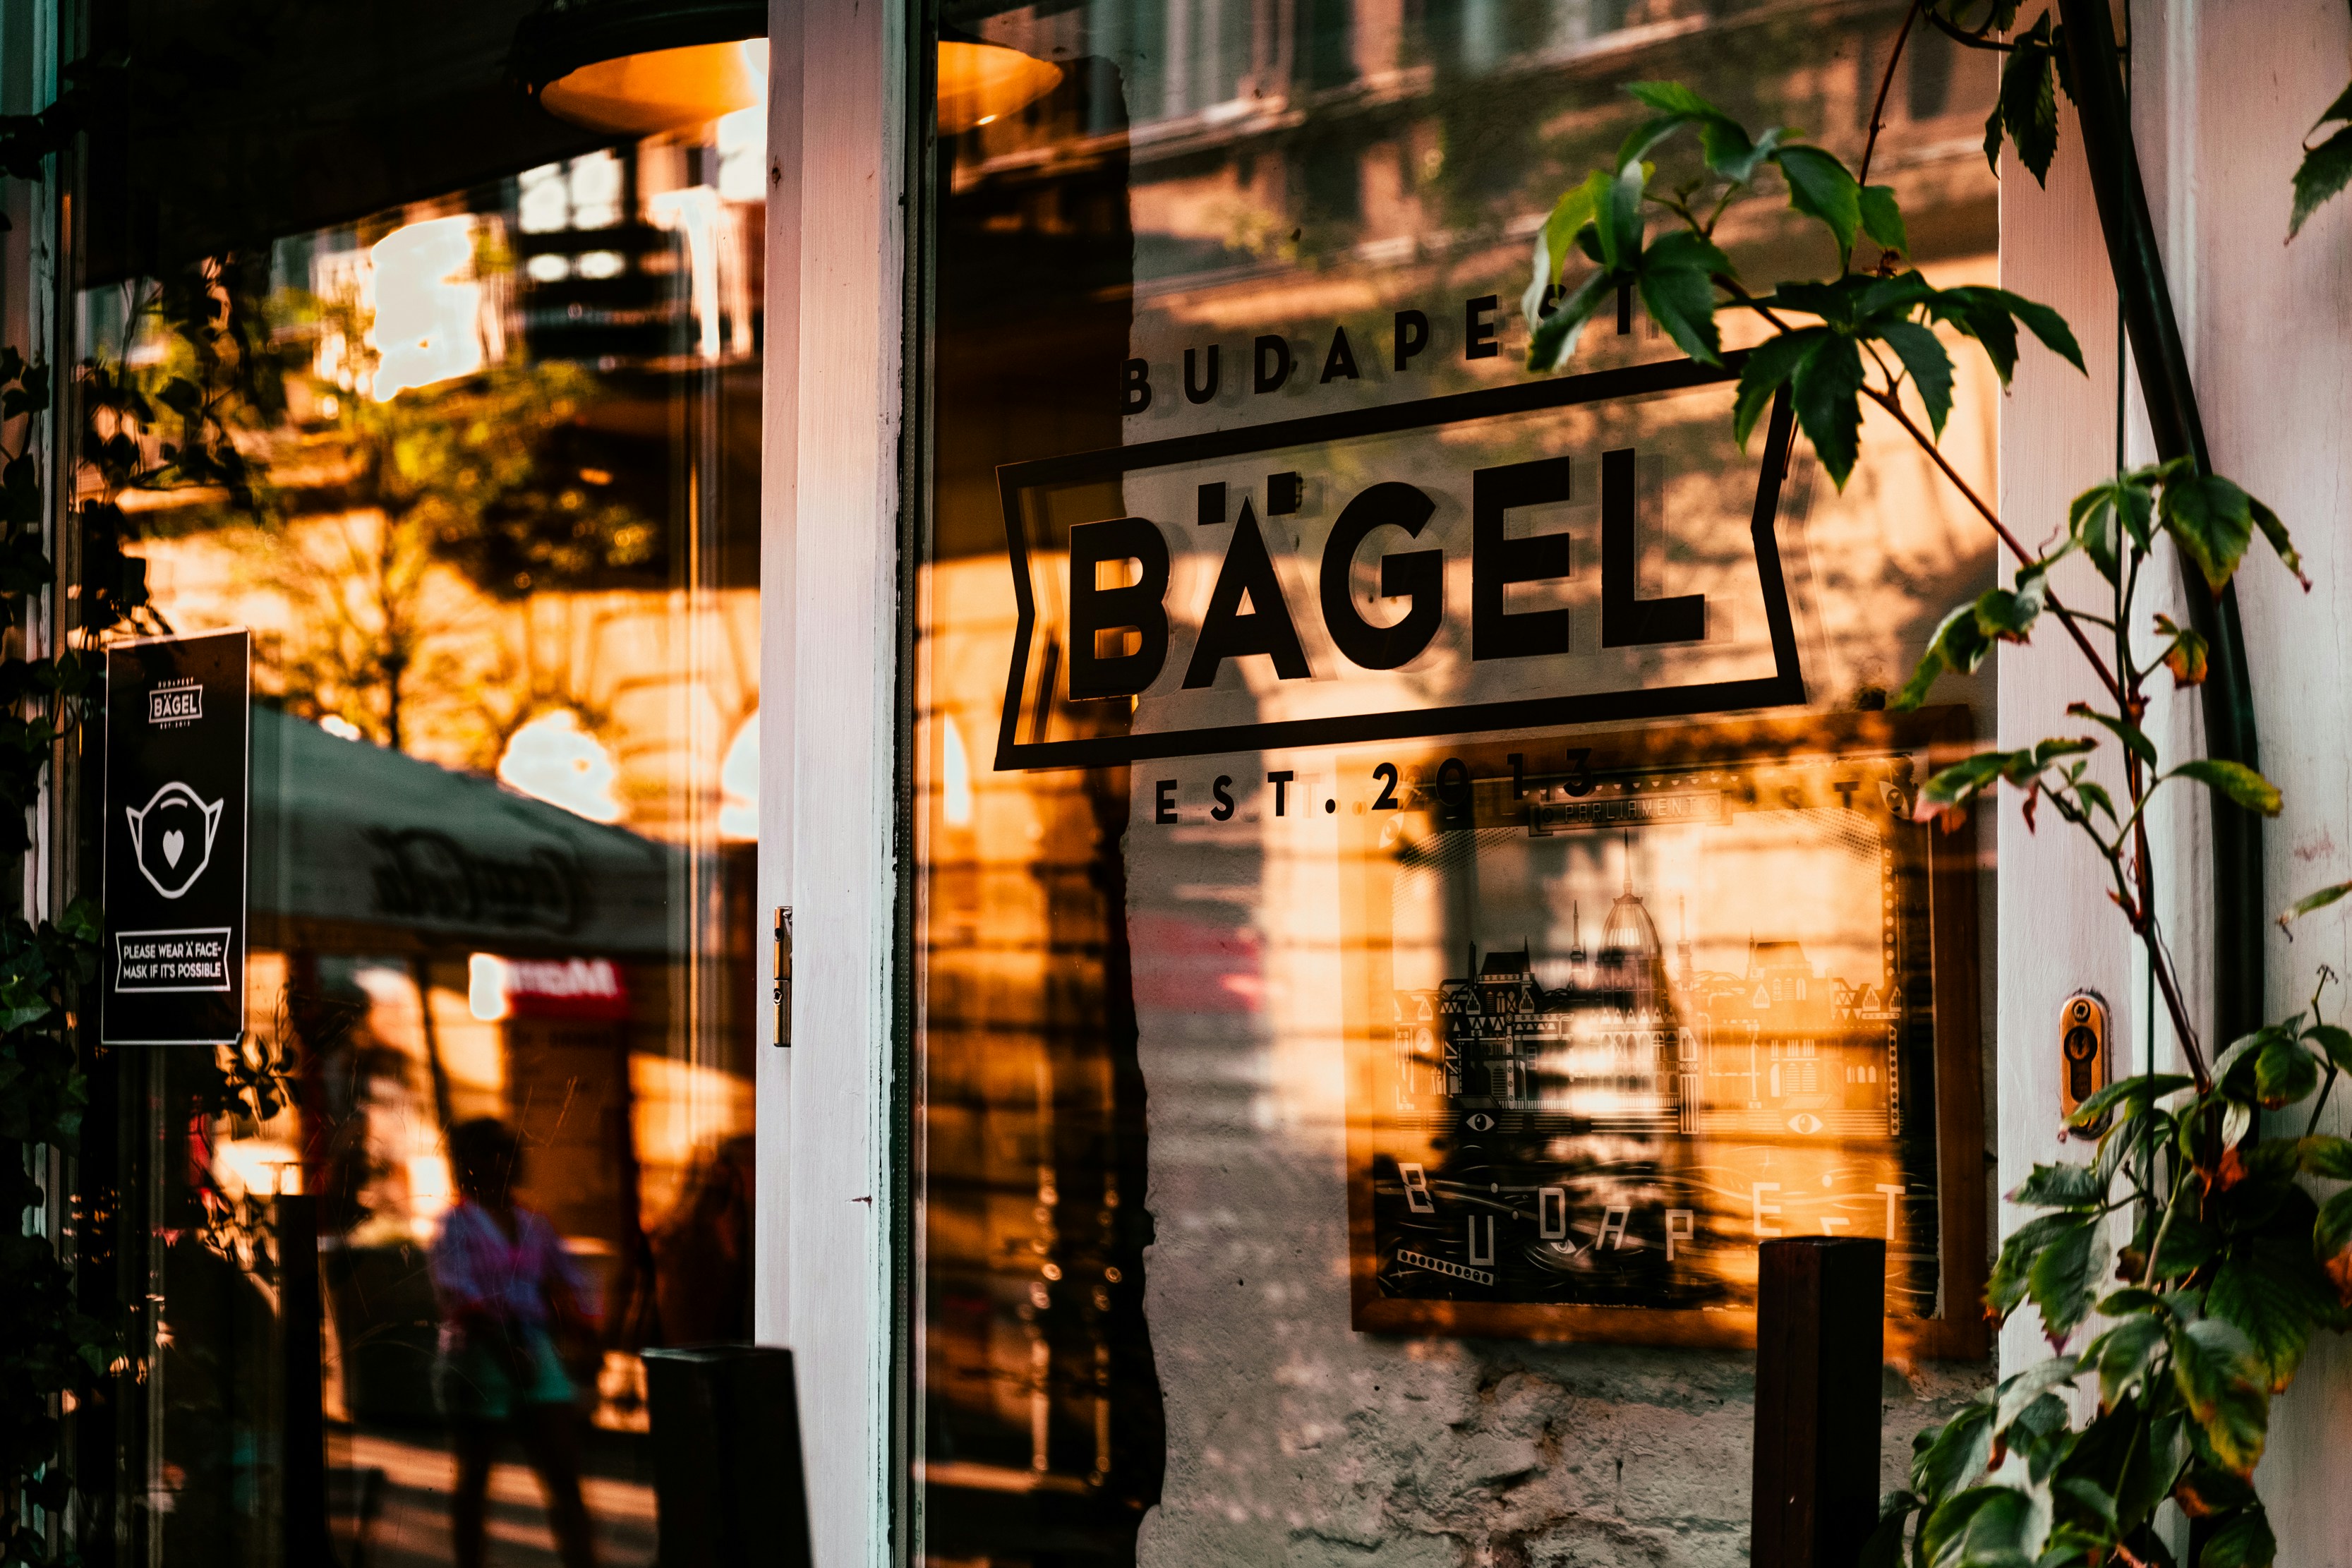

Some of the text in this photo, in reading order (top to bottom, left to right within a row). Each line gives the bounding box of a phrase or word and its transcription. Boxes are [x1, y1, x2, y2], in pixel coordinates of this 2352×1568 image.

[1068, 447, 1706, 701] BÄGEL
[154, 693, 197, 718] BÄGEL
[1564, 797, 1696, 823] PARLIAMENT
[123, 943, 156, 960] PLEASE
[158, 942, 184, 958] WEAR
[123, 963, 147, 979] MASK
[150, 963, 158, 978] IF
[178, 961, 222, 978] POSSIBLE
